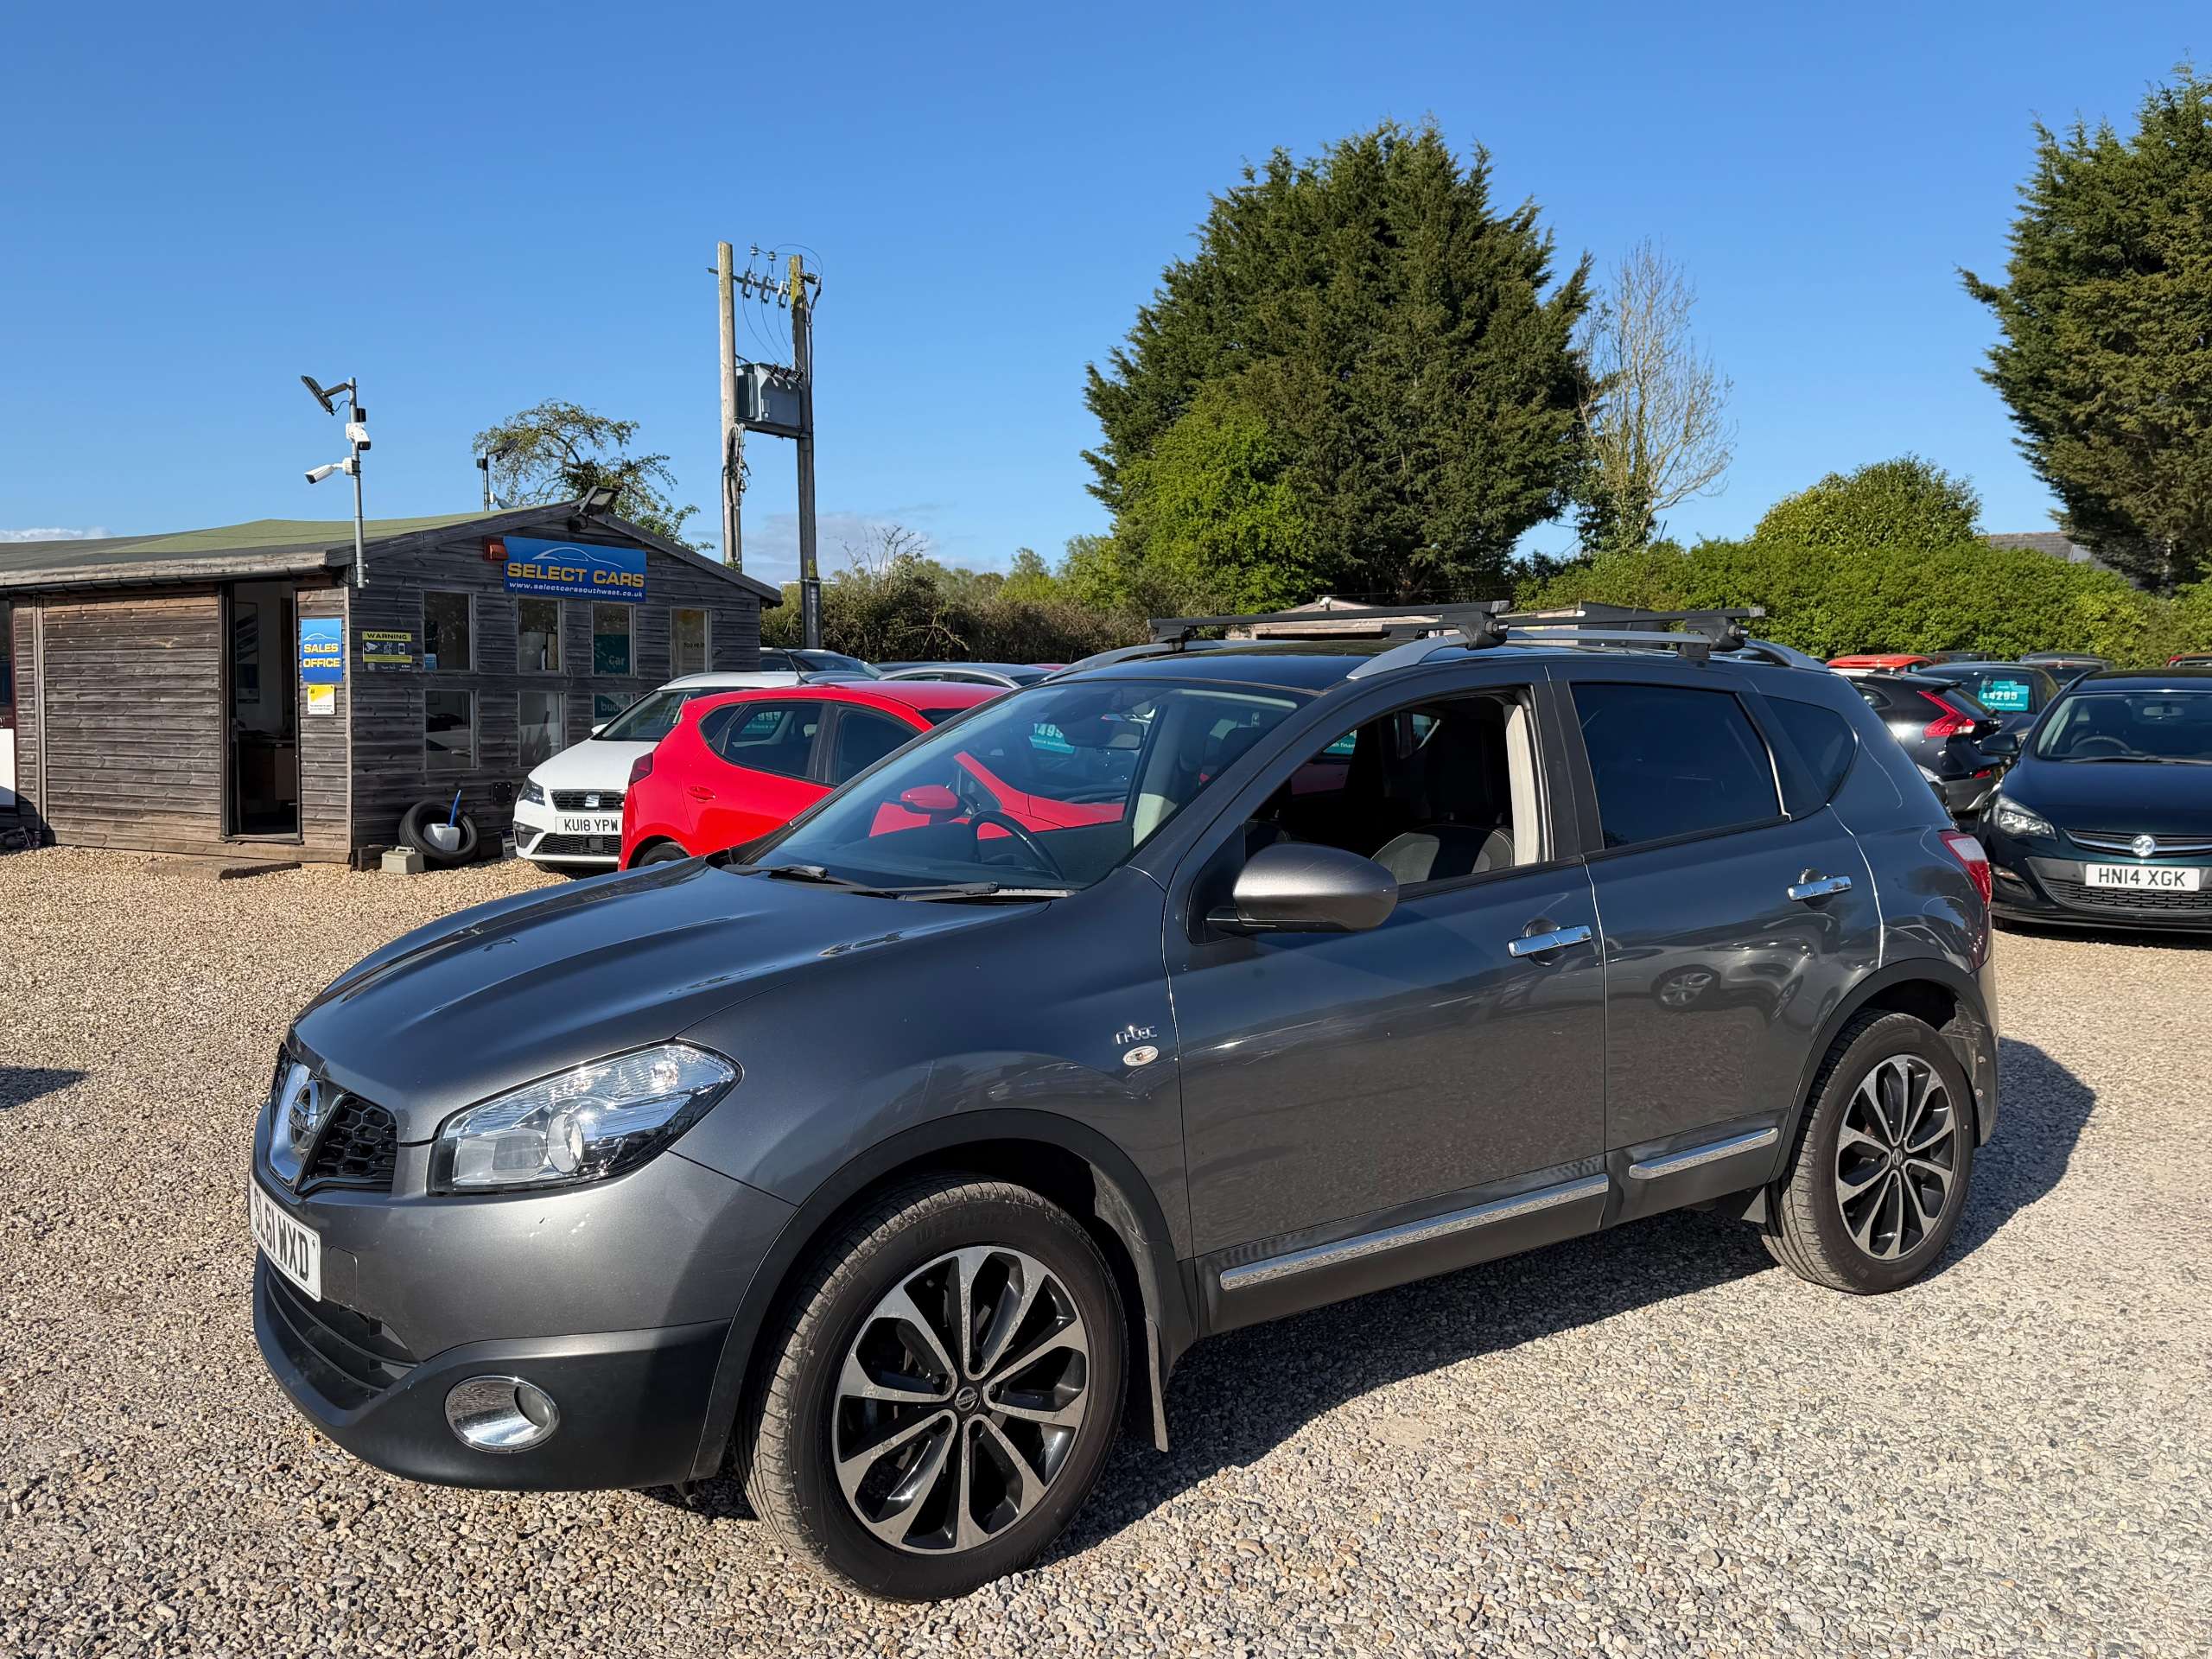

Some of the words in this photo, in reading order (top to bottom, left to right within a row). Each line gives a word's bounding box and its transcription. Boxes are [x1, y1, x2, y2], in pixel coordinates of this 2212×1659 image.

[507, 563, 588, 582] SELECT
[593, 569, 645, 588] CARS
[509, 581, 643, 598] www.selectcarssouthwest.co.uk
[303, 643, 339, 653] SALES
[302, 658, 340, 668] OFFICE
[564, 818, 591, 832] KU18
[594, 818, 618, 832] YPW
[2098, 868, 2141, 885] HN14
[2147, 869, 2186, 887] XGK
[278, 1214, 309, 1282] WXD
